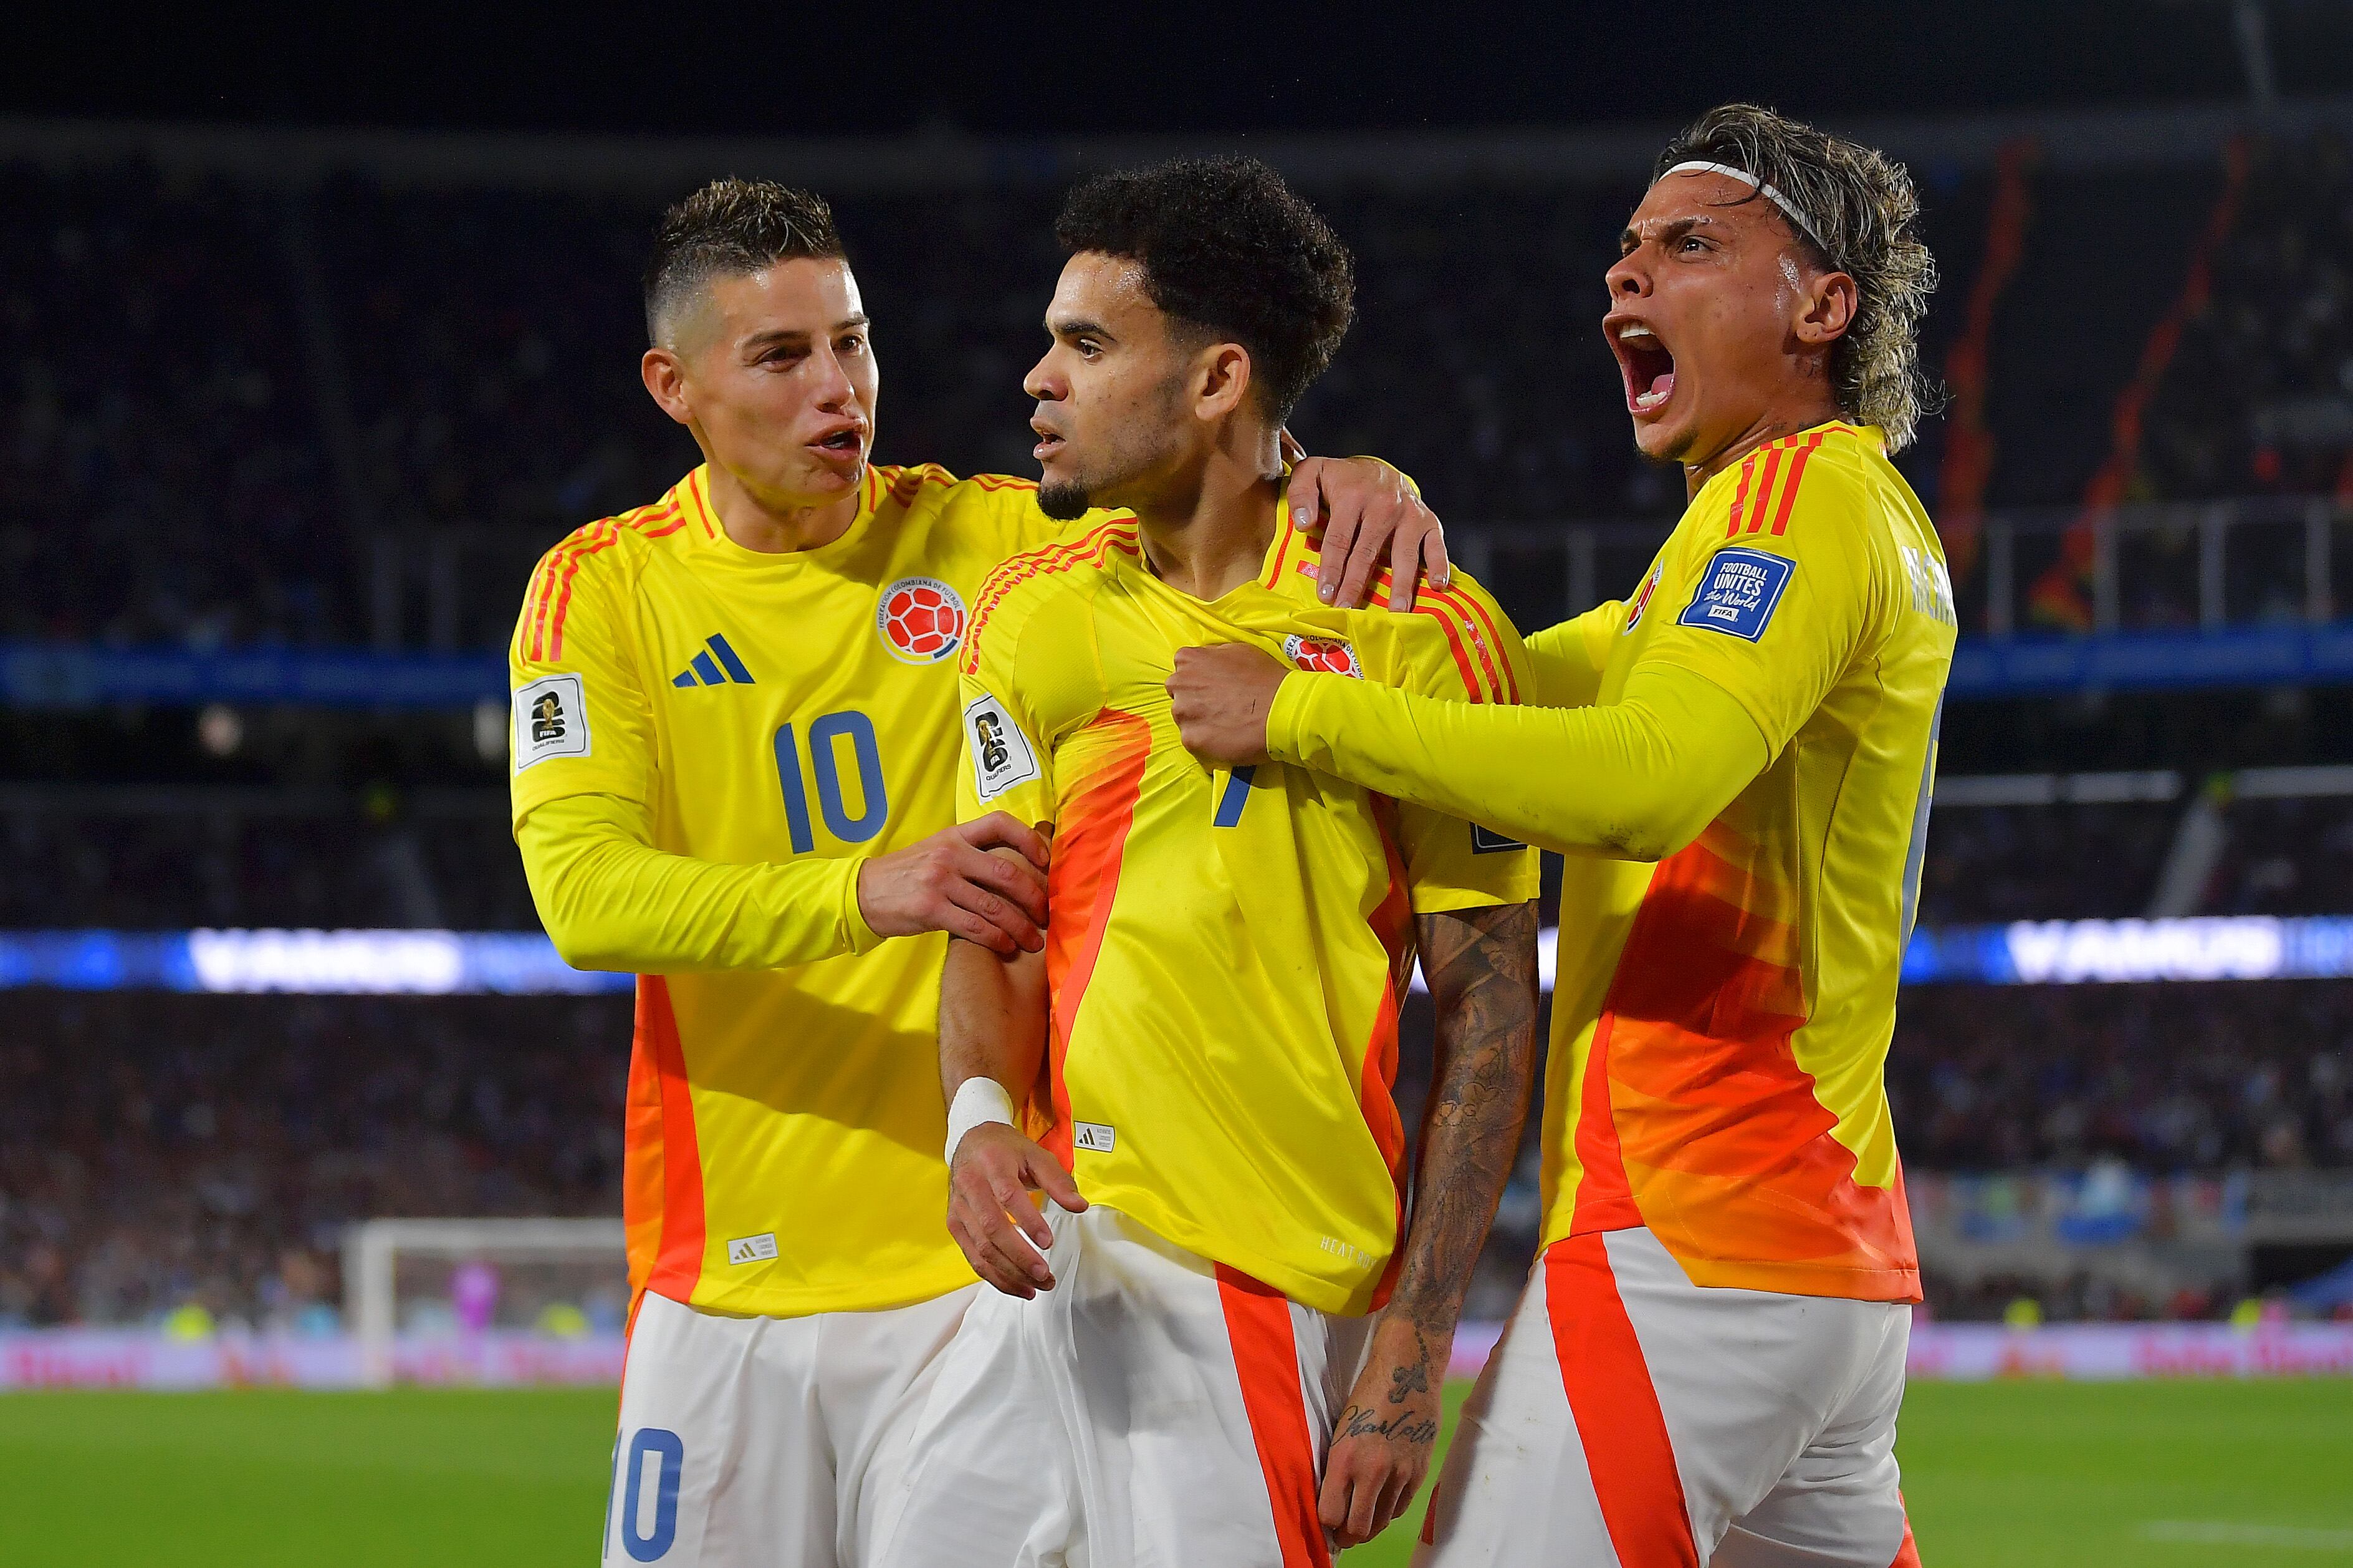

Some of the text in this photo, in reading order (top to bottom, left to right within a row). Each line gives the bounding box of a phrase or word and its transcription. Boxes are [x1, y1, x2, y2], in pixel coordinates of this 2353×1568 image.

[1720, 562, 1768, 581] FOOTBALL
[891, 580, 932, 593] COLOMBIANA
[1713, 573, 1765, 596] UNITES
[1722, 590, 1761, 612] World
[1713, 608, 1733, 618] FIFA
[774, 710, 888, 854] 10
